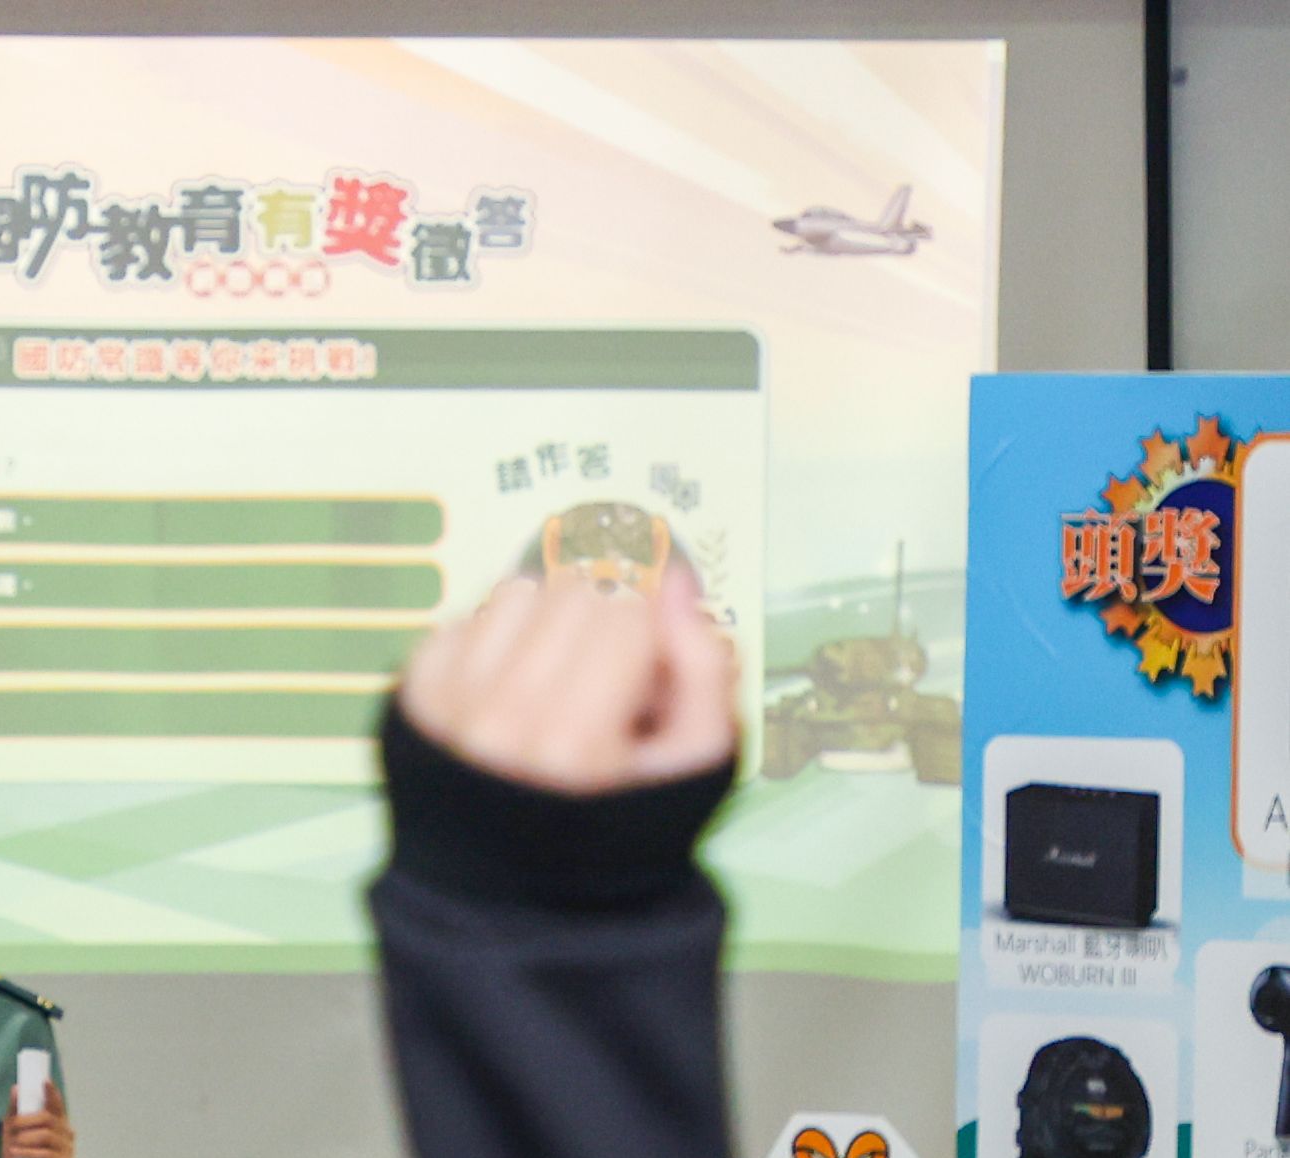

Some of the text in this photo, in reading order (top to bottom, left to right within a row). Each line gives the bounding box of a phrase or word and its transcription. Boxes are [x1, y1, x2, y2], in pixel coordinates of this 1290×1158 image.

[1059, 507, 1221, 604] 頭獎
[994, 930, 1168, 961] Marshall 藍牙喇叭
[1019, 963, 1115, 987] WOBURN
